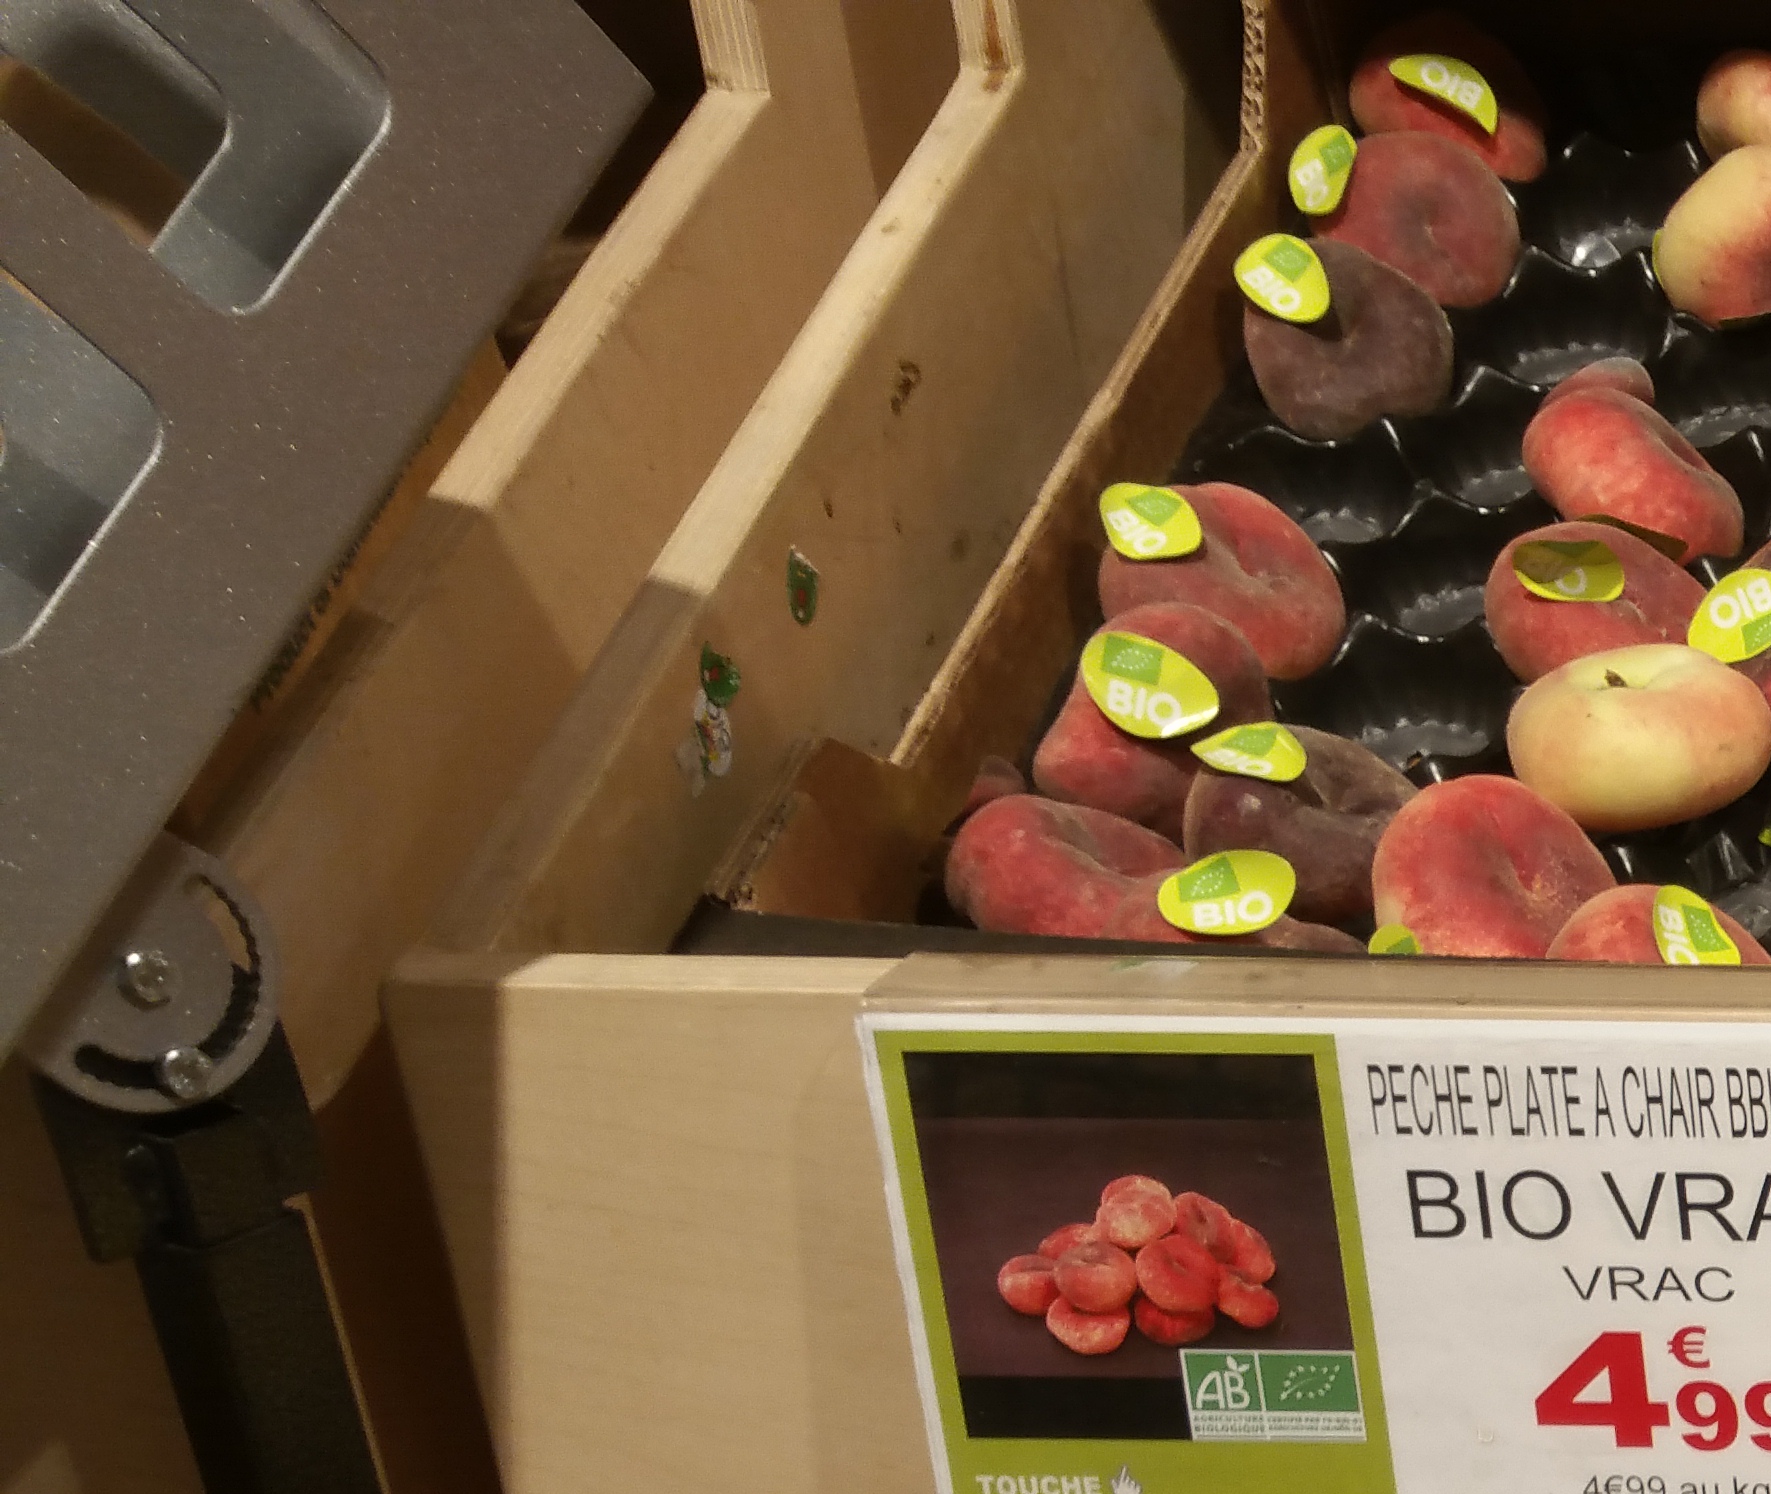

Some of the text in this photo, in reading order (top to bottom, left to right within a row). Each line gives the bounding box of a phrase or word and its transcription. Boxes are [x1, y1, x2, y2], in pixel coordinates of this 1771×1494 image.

[1419, 61, 1484, 109] BIO
[1240, 265, 1301, 314] BIO
[1105, 506, 1168, 555] BIO
[1106, 678, 1181, 729] BIO
[1202, 747, 1273, 776] BIO
[1191, 888, 1273, 929] BIO
[1659, 904, 1699, 965] BIO
[1366, 1063, 1479, 1136] PECHE
[1482, 1065, 1587, 1137] PLATE
[1594, 1066, 1617, 1138] A
[1621, 1065, 1721, 1140] CHAIR
[1406, 1169, 1573, 1241] BIO
[1562, 1265, 1736, 1302] VRAC
[1195, 1370, 1251, 1410] AB
